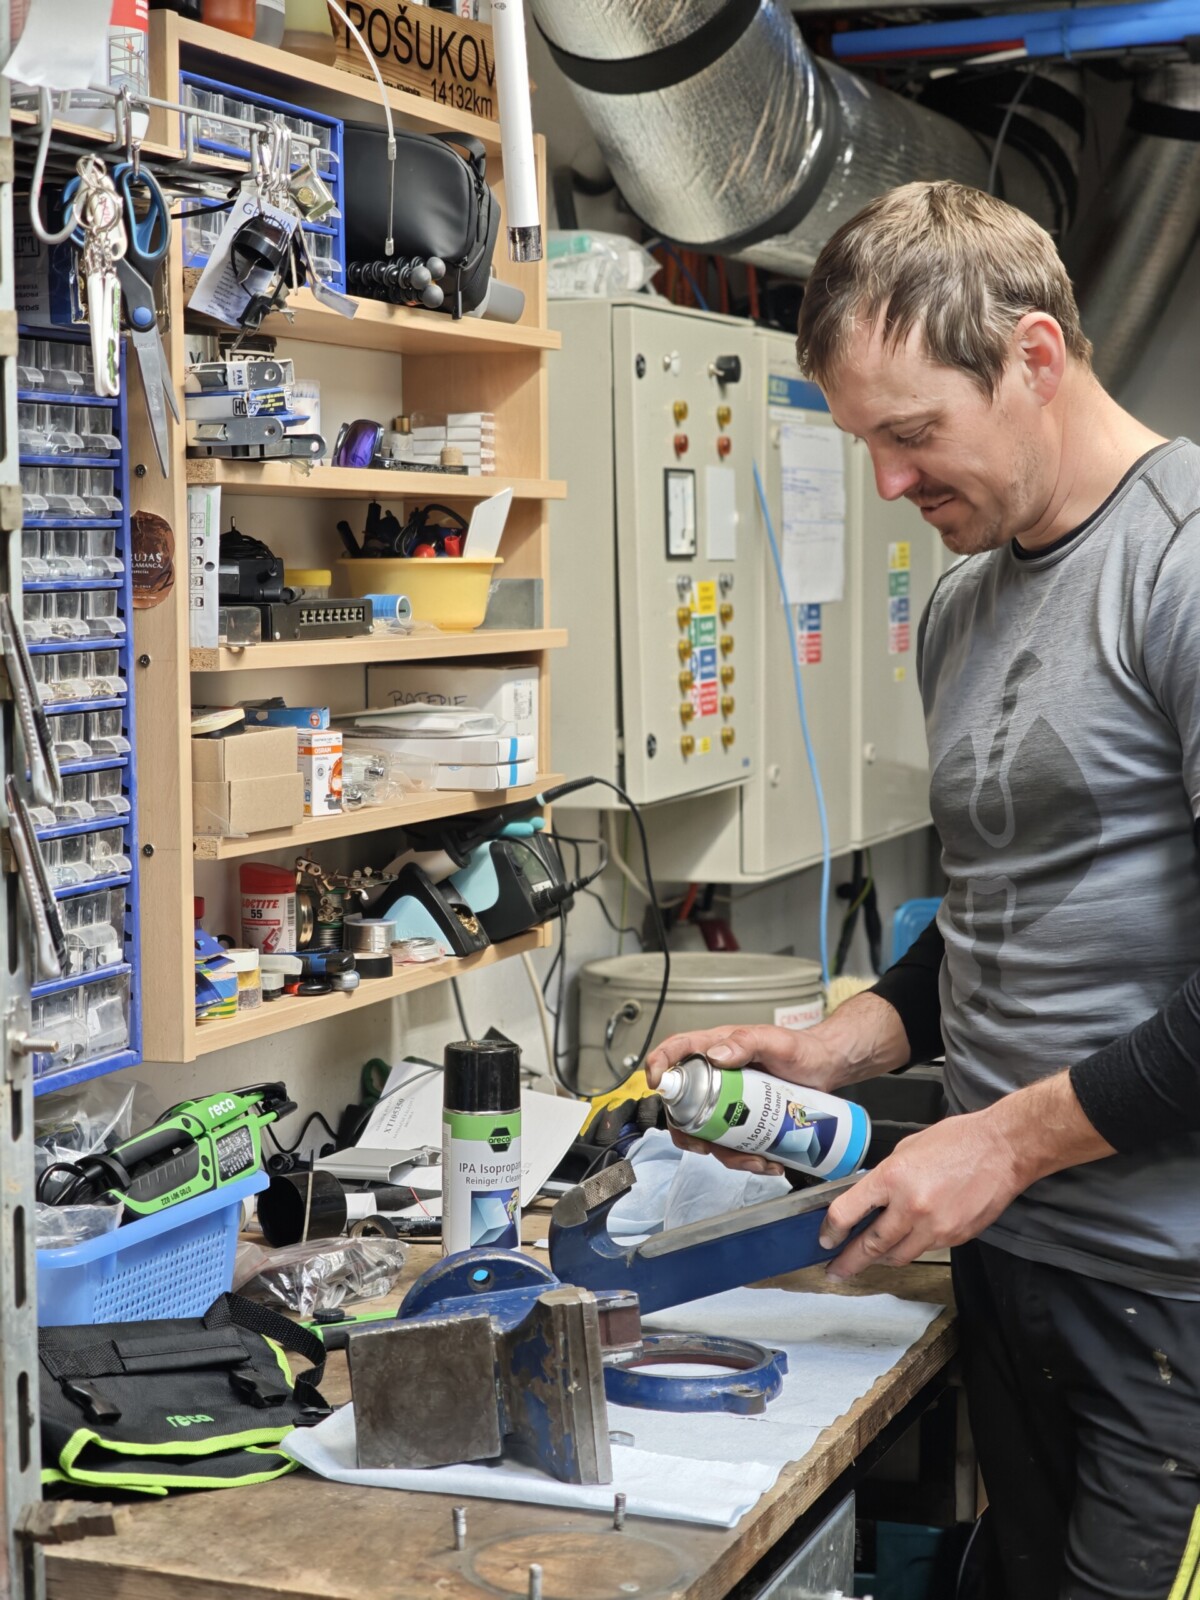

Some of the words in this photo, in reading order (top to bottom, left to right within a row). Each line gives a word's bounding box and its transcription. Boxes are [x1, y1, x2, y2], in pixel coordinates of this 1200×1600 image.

[430, 78, 493, 118] 14132km
[241, 898, 280, 909] LOCTITE
[250, 909, 263, 919] 55
[208, 1098, 236, 1120] reca
[747, 1080, 772, 1142] Isopropanol
[771, 1091, 782, 1122] Cleaner
[459, 1162, 476, 1174] IPA
[465, 1176, 499, 1187] Reiniger
[165, 1414, 215, 1428] reca
